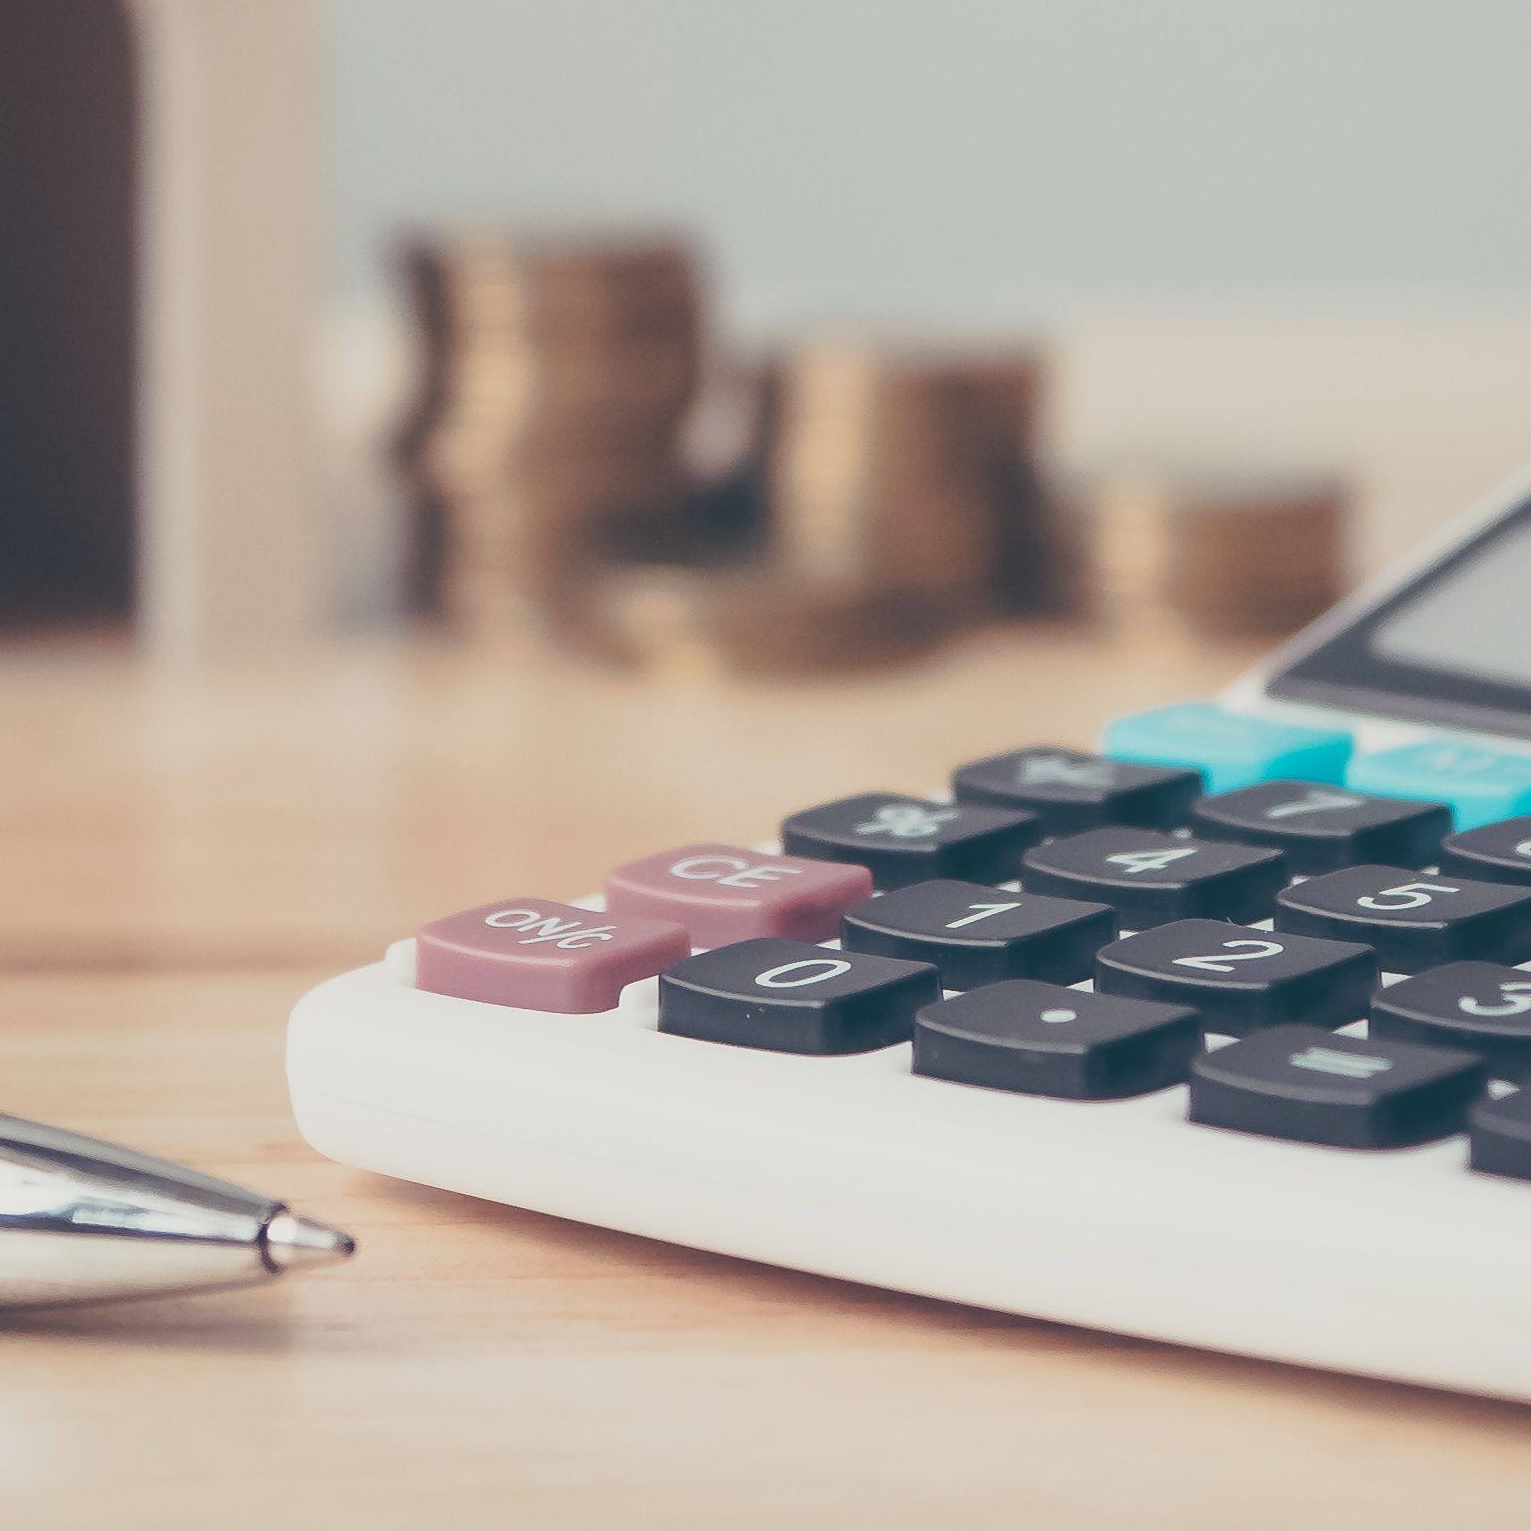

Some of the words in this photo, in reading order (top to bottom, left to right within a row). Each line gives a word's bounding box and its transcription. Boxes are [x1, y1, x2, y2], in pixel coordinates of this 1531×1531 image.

[1266, 790, 1365, 820] 7
[669, 855, 804, 888] CE
[1107, 848, 1196, 873] 4
[1357, 883, 1460, 909] 5
[484, 908, 617, 950] ON/C
[946, 903, 1022, 928] 1
[1172, 940, 1283, 972] 2
[755, 960, 851, 987] 0
